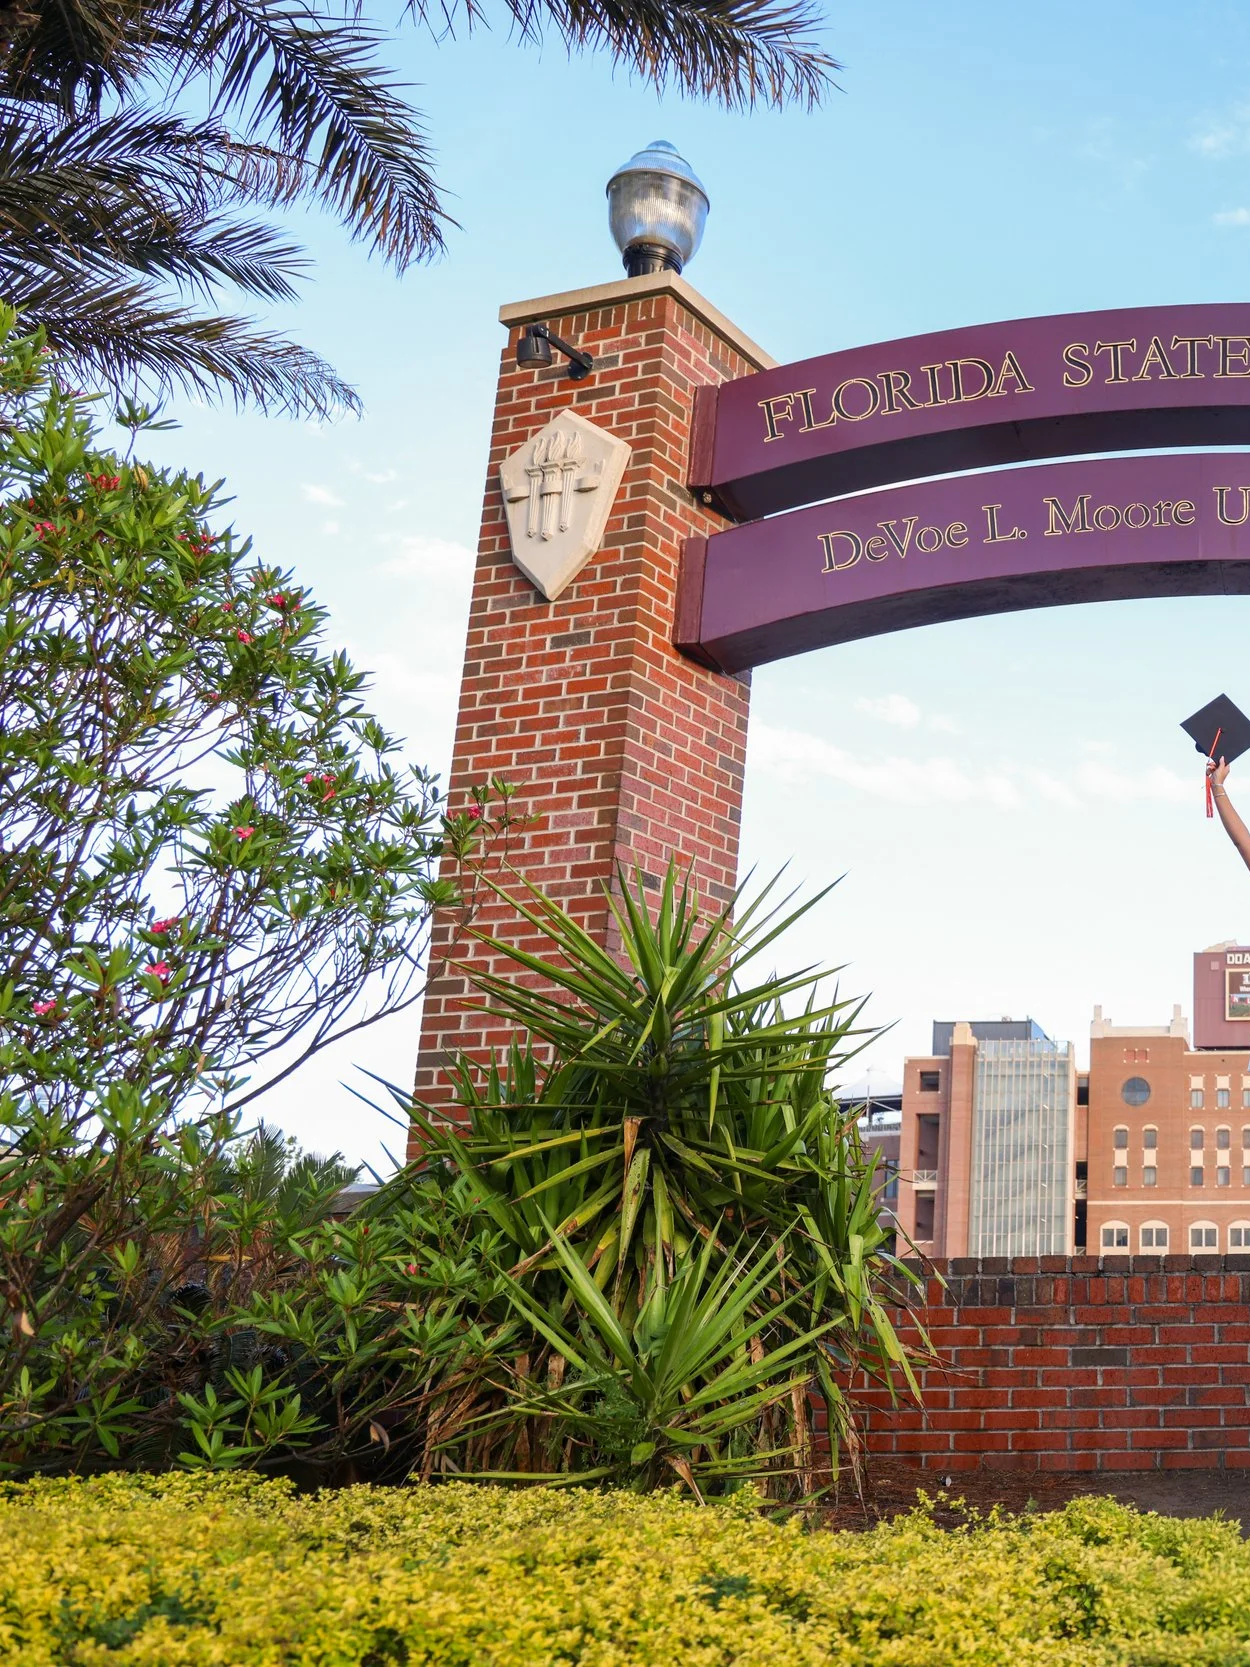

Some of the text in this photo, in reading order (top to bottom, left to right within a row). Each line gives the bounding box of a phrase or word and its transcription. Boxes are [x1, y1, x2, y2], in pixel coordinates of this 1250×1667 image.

[757, 350, 1034, 443] FLORIDA
[816, 514, 970, 575] DeVoe
[981, 502, 1028, 544] L.
[1043, 493, 1196, 537] Moore
